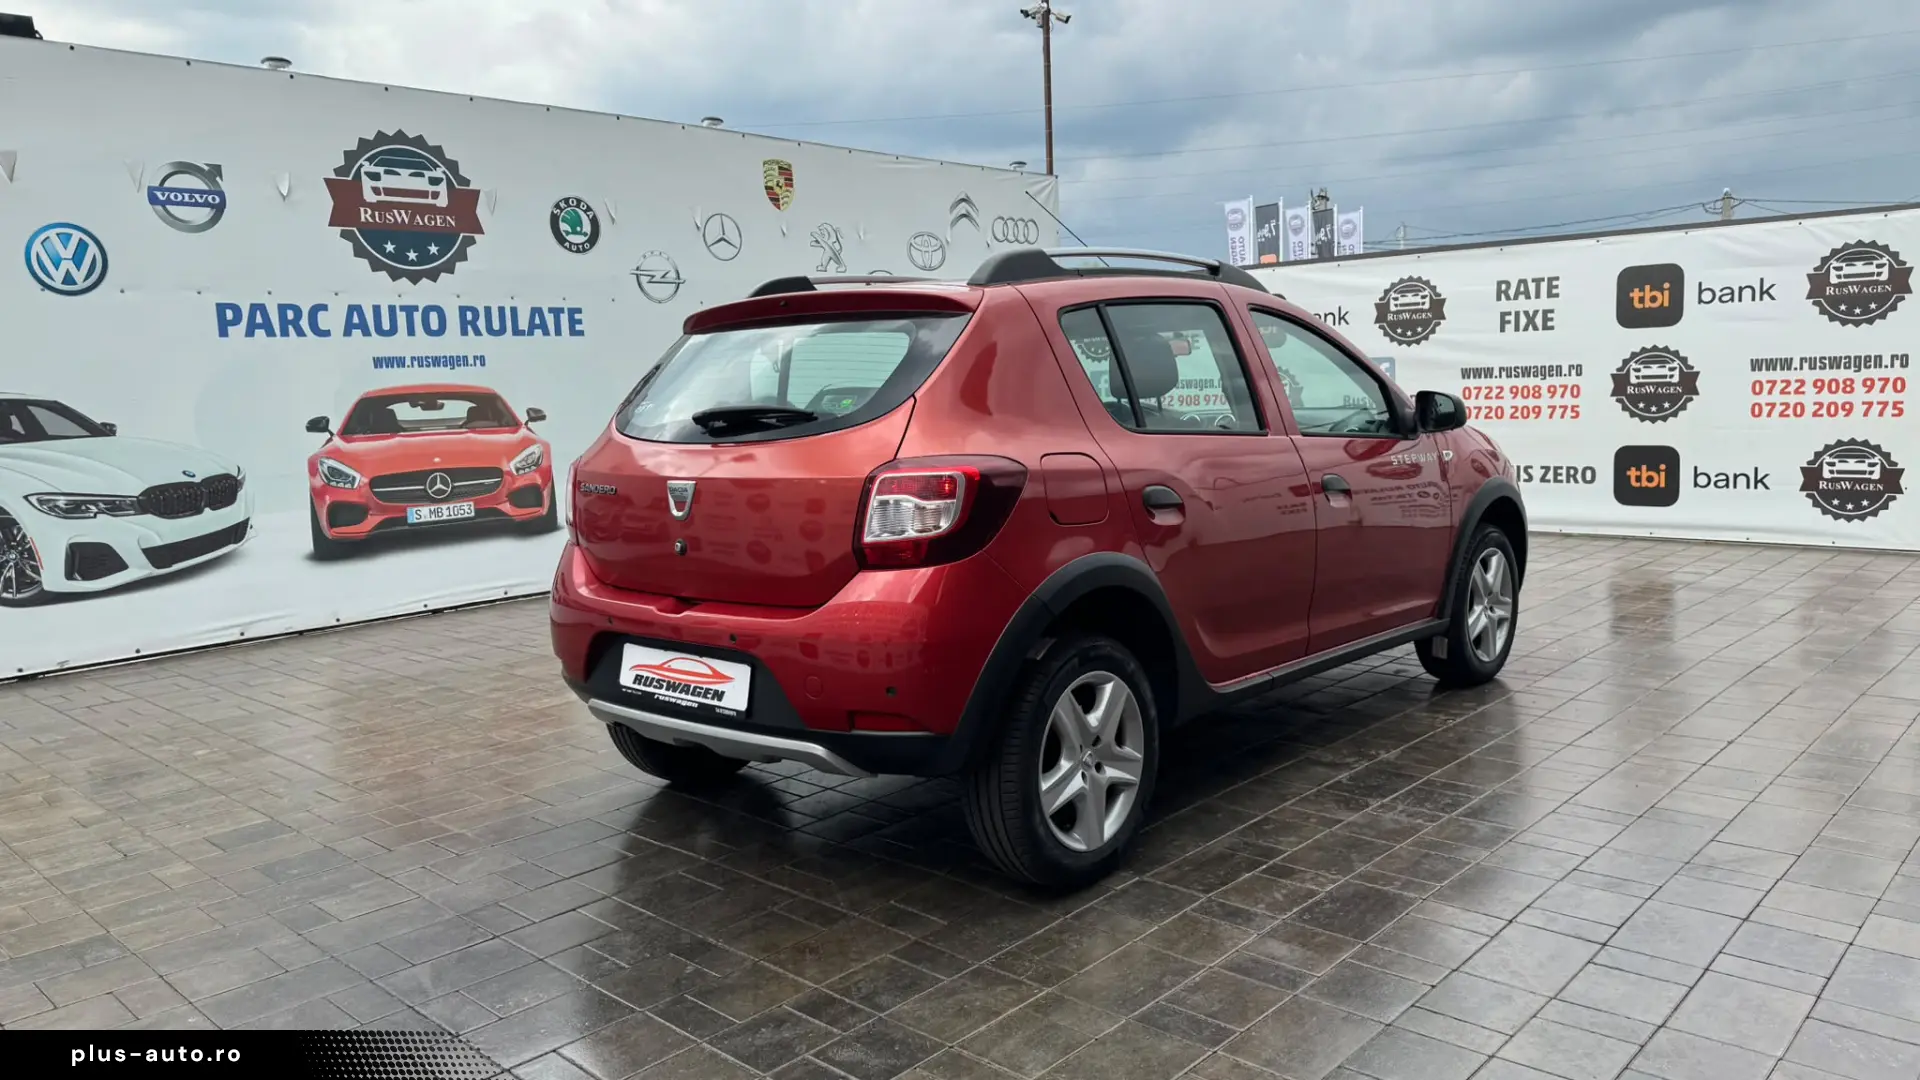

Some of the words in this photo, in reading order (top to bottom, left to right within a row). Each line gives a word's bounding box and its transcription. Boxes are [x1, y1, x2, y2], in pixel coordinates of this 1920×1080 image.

[153, 191, 220, 204] VOLVO
[564, 241, 590, 251] AUTO
[1496, 276, 1560, 302] RATE
[1629, 282, 1670, 309] tbi
[1697, 278, 1777, 305] bank
[215, 302, 331, 338] PARC
[342, 304, 447, 338] AUTO
[458, 305, 585, 337] RULATE
[1499, 309, 1555, 333] FIXE
[372, 354, 486, 370] www.ruswagen.ro
[1750, 353, 1909, 373] www.ruswagen.ro
[1460, 364, 1583, 380] www.ruswagen.ro
[1462, 385, 1505, 400] 0722
[1509, 385, 1542, 399] 908
[1547, 384, 1581, 399] 970
[1751, 378, 1806, 395] 0722
[1812, 378, 1855, 395] 908
[1862, 377, 1907, 394] 970
[1178, 394, 1200, 406] 908
[1509, 405, 1542, 420] 209
[1547, 405, 1581, 419] 775
[1750, 401, 1806, 418] 0720
[1812, 401, 1854, 418] 209
[1861, 400, 1905, 418] 775
[1390, 452, 1438, 465] STEPWAY
[1539, 465, 1597, 485] ZERO
[1626, 464, 1667, 488] tbi
[1692, 466, 1771, 490] bank
[580, 483, 616, 495] SANDERO
[415, 509, 422, 520] S
[429, 507, 444, 519] MB
[446, 504, 473, 517] 1053
[632, 674, 726, 702] RUSWAGEN
[654, 694, 699, 708] ruswagen
